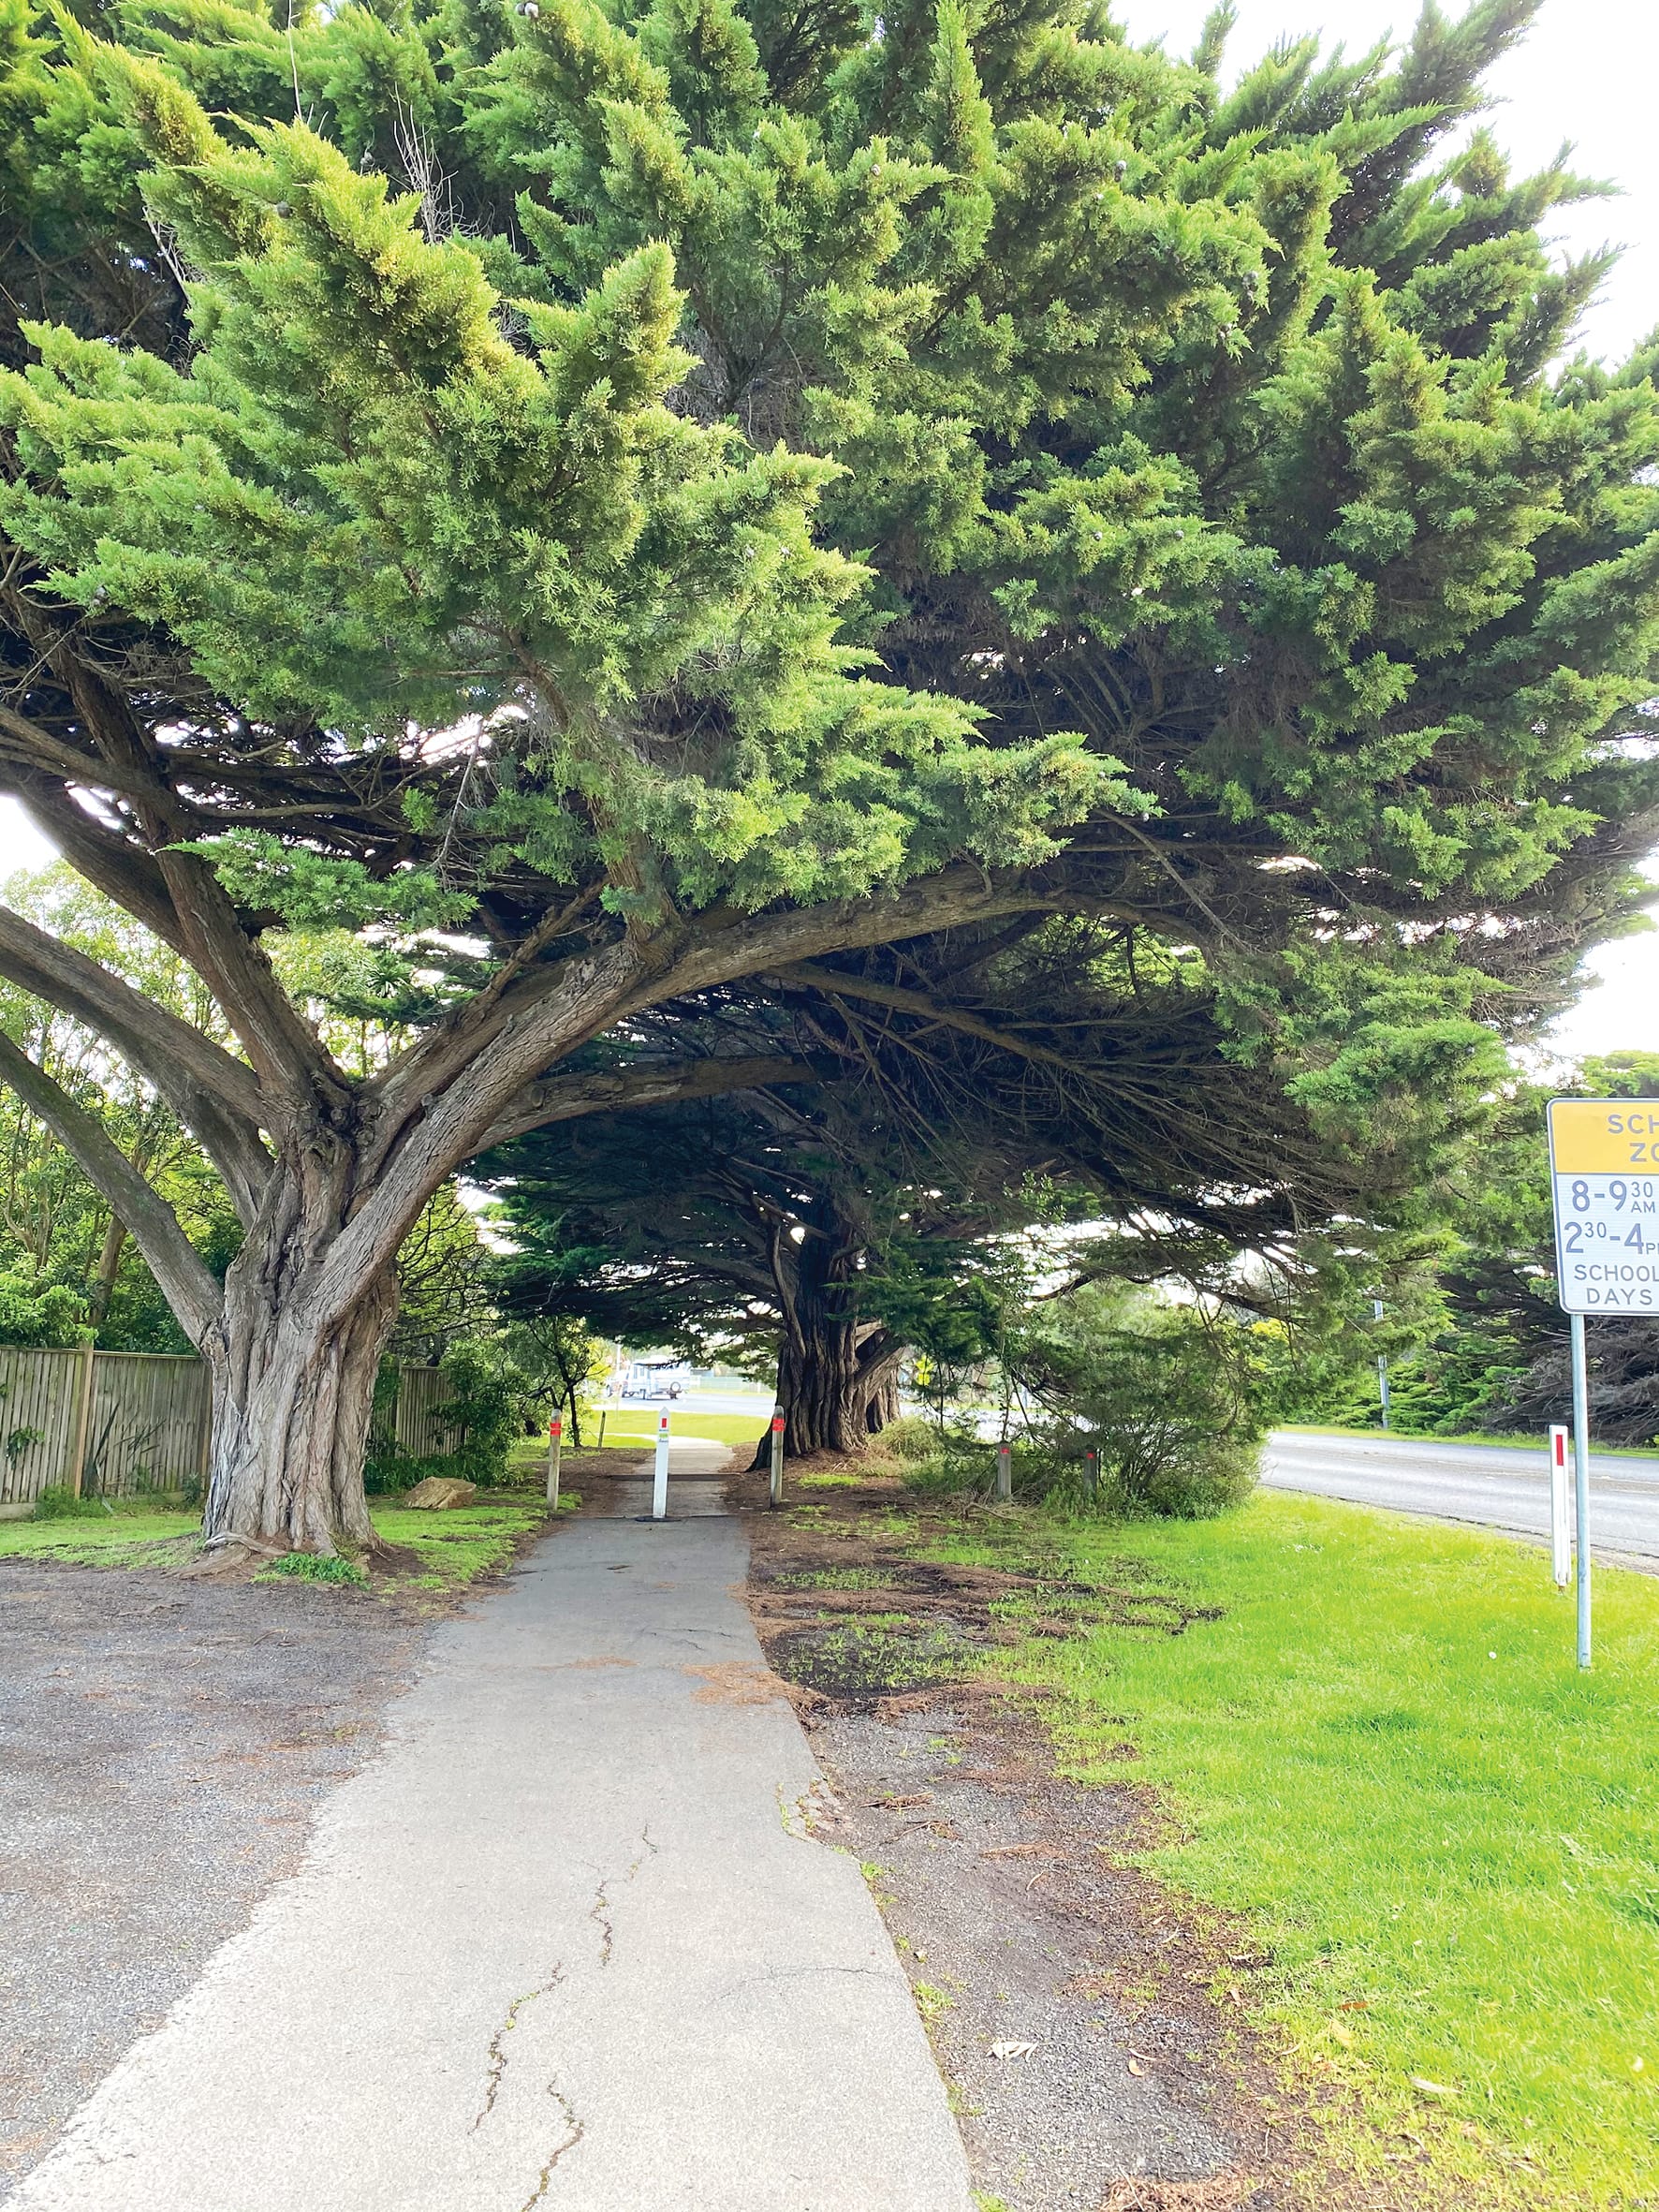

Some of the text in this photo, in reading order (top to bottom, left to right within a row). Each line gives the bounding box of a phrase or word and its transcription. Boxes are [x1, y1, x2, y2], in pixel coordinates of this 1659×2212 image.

[1630, 1201, 1655, 1214] AM
[1574, 1264, 1659, 1282] SCHOOL
[1587, 1288, 1652, 1305] DAYS
